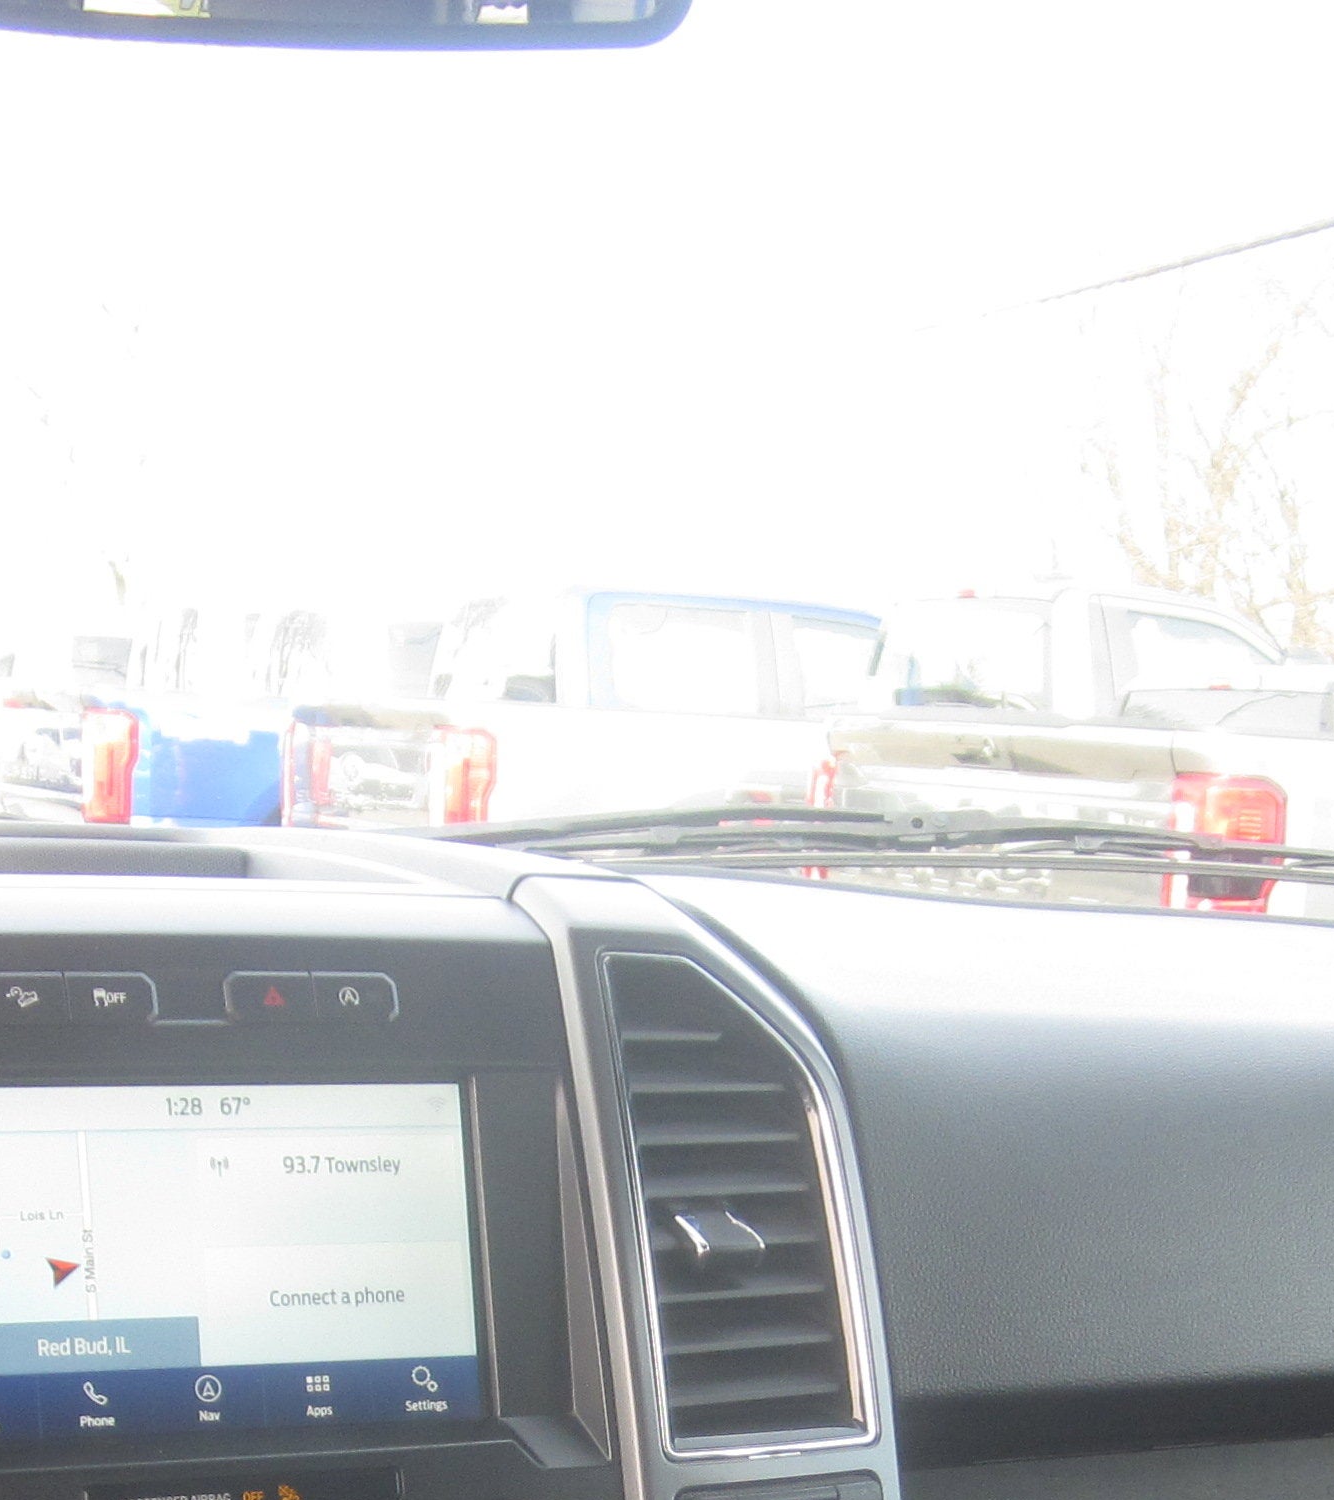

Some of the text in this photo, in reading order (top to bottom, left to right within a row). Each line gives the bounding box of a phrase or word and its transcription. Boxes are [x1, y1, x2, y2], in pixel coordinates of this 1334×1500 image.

[106, 991, 127, 1005] OFF
[166, 1096, 251, 1116] 1:28 67°
[282, 1155, 401, 1176] 93.7 Townsley
[20, 1210, 64, 1222] Lois Ln
[83, 1247, 95, 1279] Main
[270, 1287, 405, 1307] Connect a phone
[37, 1336, 132, 1356] Red Bud, IL
[306, 1404, 333, 1418] Apps
[405, 1400, 448, 1413] Settings
[79, 1415, 116, 1428] Phone
[199, 1410, 221, 1422] Nav
